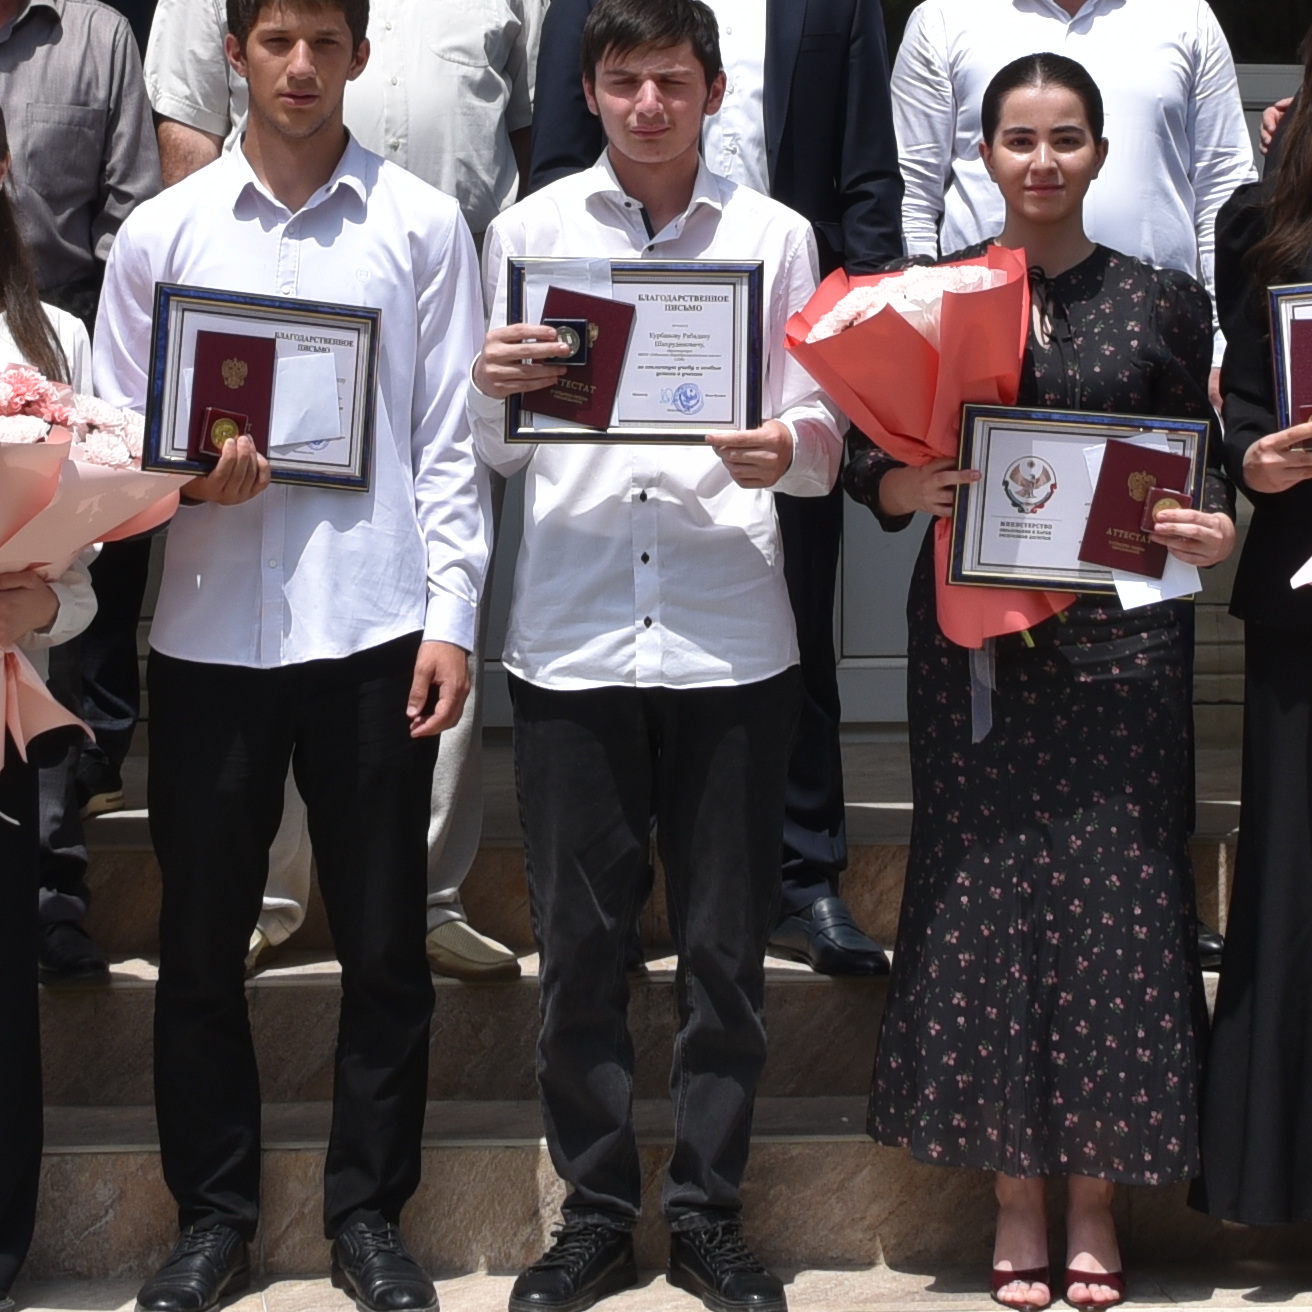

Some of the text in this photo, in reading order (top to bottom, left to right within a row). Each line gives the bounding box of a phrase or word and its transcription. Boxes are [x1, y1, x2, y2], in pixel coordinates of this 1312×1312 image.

[638, 294, 729, 302] БЛАГОДАРСТВЕННОЕ
[664, 304, 703, 312] ПИСЬМО
[559, 378, 597, 394] ТЕСТАТ
